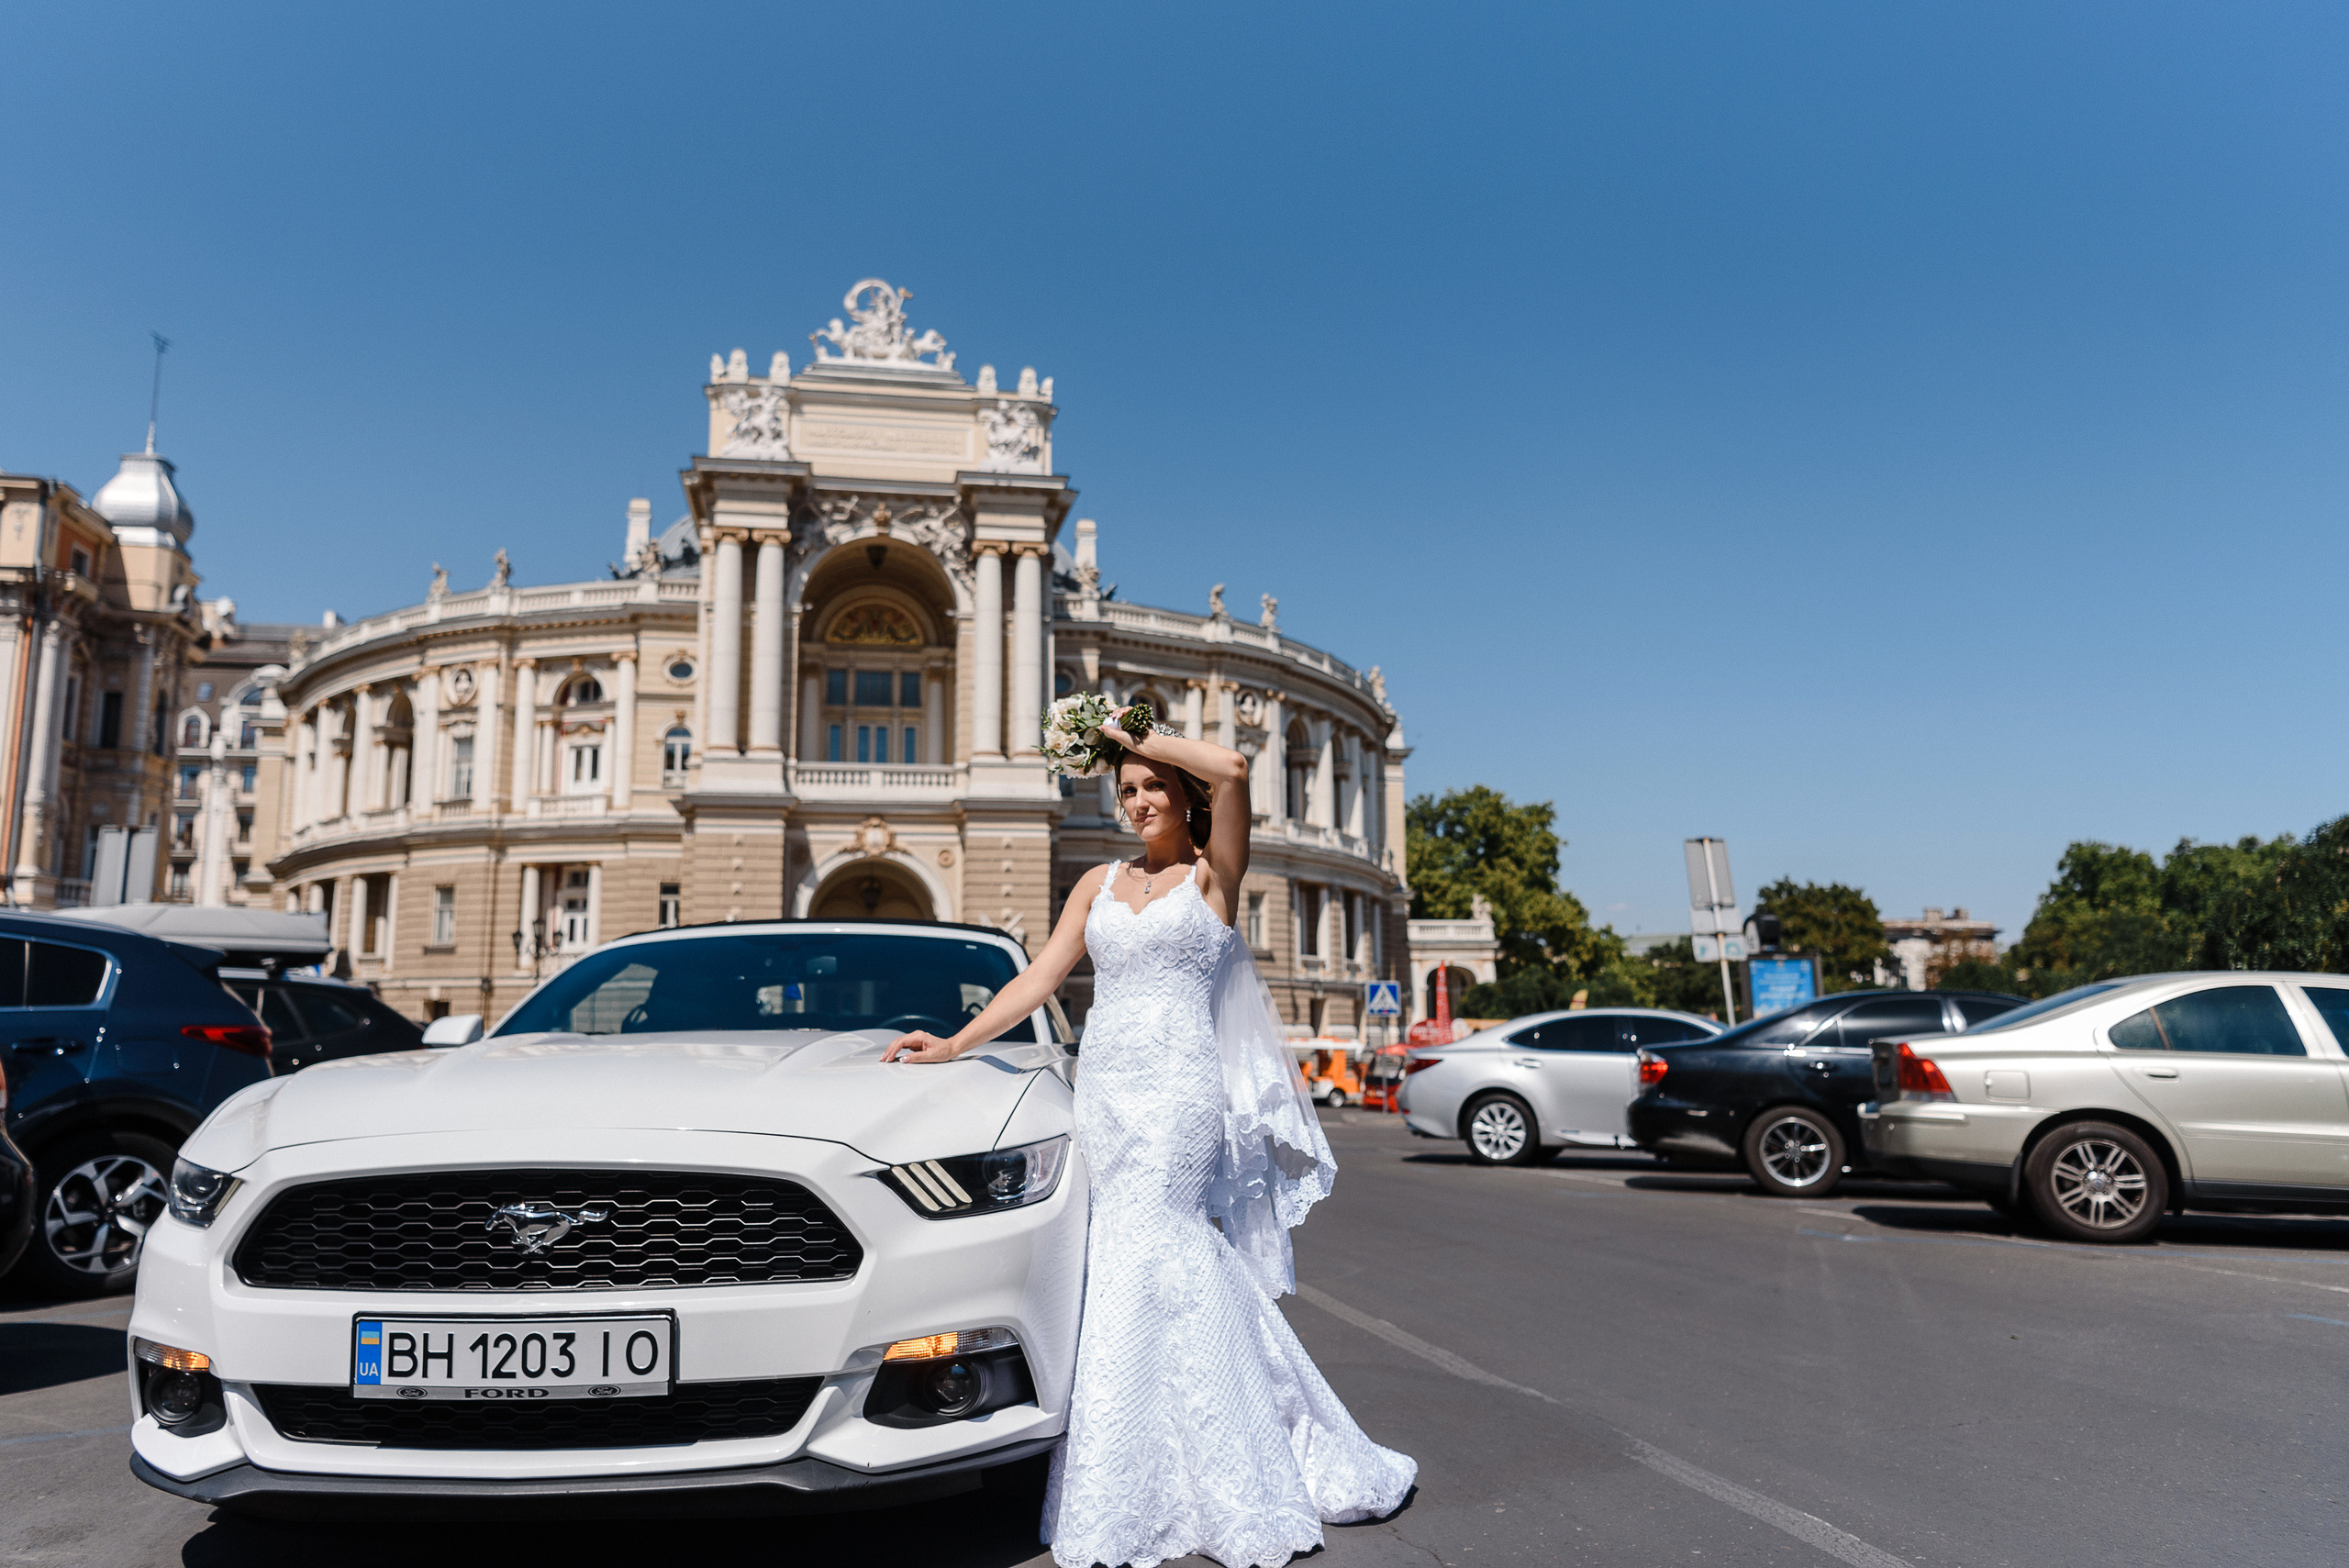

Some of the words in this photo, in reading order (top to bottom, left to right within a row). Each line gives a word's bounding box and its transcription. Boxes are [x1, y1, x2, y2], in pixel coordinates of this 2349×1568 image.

[359, 1362, 379, 1377] UA
[387, 1332, 454, 1379] BH
[469, 1331, 576, 1379] 1203
[403, 1388, 421, 1397] Ford
[464, 1388, 550, 1399] FORD
[595, 1386, 614, 1396] Ford
